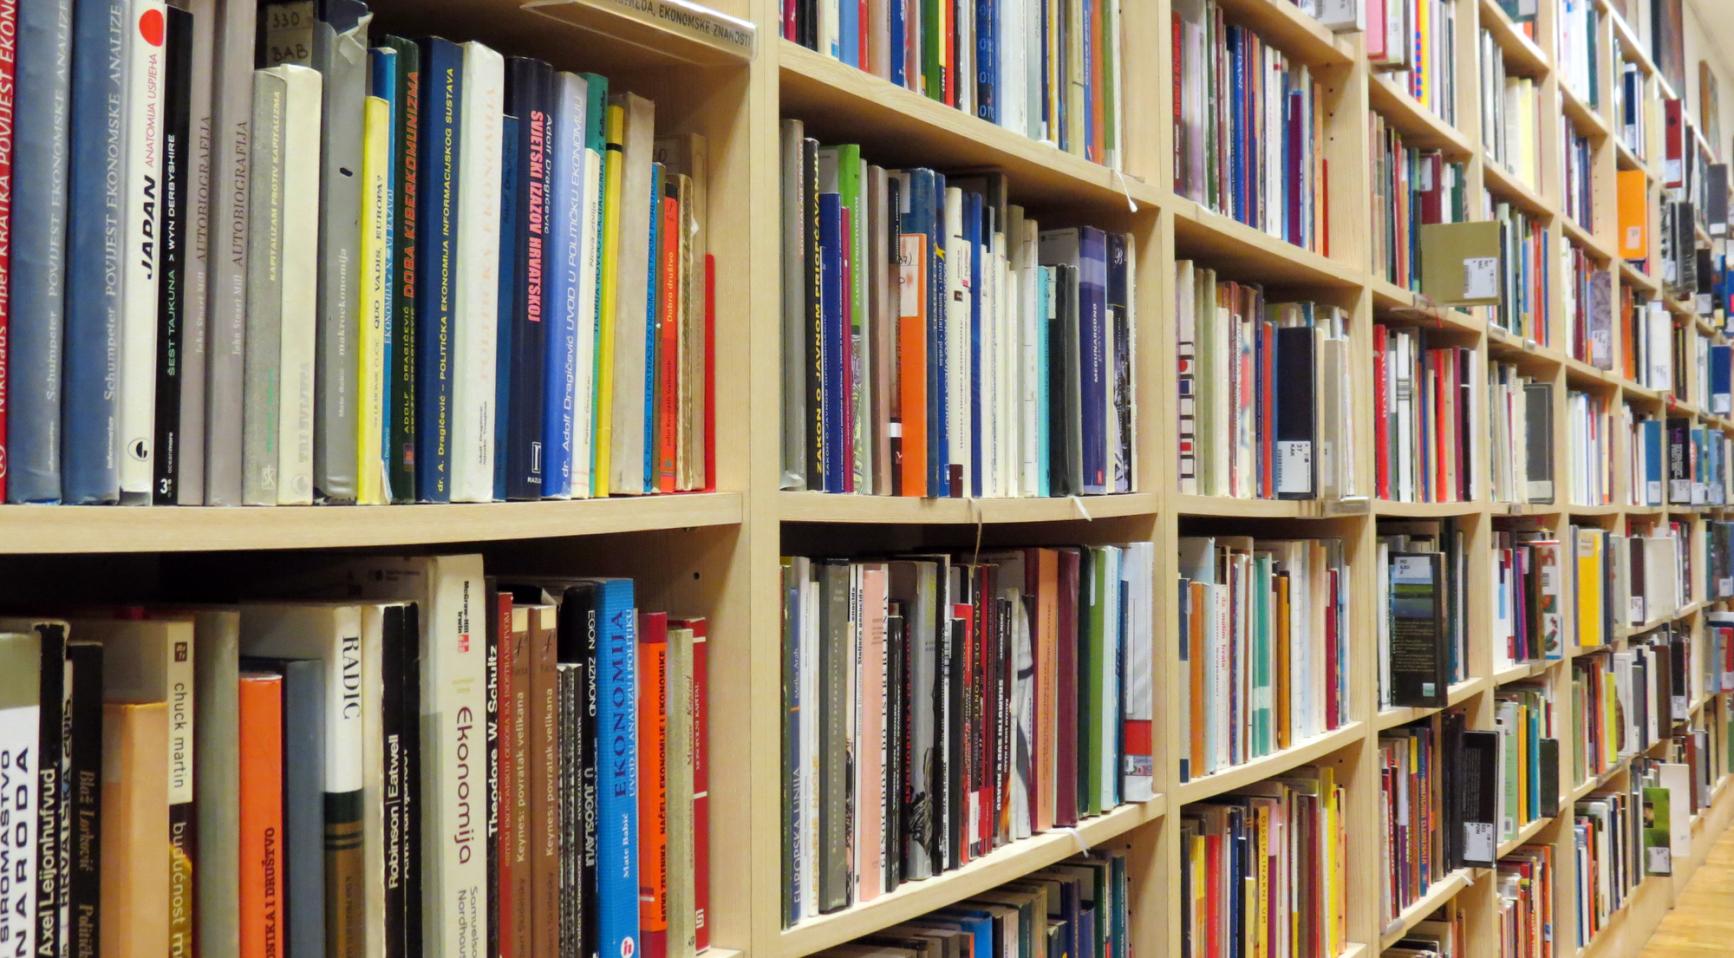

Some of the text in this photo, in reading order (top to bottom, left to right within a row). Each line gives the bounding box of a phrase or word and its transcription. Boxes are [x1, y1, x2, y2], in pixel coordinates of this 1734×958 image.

[659, 4, 710, 34] EKONOMSKE
[0, 69, 13, 165] POVIJEST
[403, 71, 418, 239] KIBERKOMUNIZMA
[544, 113, 553, 155] Adolf
[570, 95, 582, 187] EKONOMIJU
[46, 1, 68, 403] Schumpeter POVIJEST EKONOMSKE ANALIZE
[103, 5, 122, 401] Schumpeter POVIJEST EKONOMSKE ANALIZE
[142, 54, 158, 281] JAPAN ANATOMIJA USPJEHA
[167, 134, 175, 217] DERBYSHIRE
[231, 120, 248, 267] AUTOBIOGRAFIJA
[270, 91, 280, 281] KAPITALIZAM PROTIV KAPITALIZMA
[167, 220, 175, 251] WYN
[527, 110, 544, 323] SVJETSKI IZAZOV HRVATSKOJ
[567, 189, 578, 268] POLITIČKU
[167, 270, 176, 334] TAJKUNA
[337, 248, 348, 357] makroekonomija
[403, 246, 415, 298] DOBA
[437, 67, 454, 492] dr. A. Dragičević POLITIČKA EKONOMIJA INFORMACIJSKOG SUSTAVA
[566, 287, 576, 331] UVOD
[569, 271, 576, 283] U
[167, 339, 176, 377] ŠEST
[562, 334, 574, 411] Dragičević
[816, 386, 822, 402] O
[562, 415, 571, 452] Adolf
[588, 610, 596, 717] EGON ZIZMOND
[625, 608, 634, 672] POLITIKU
[487, 644, 499, 837] Theodore W. Schultz
[515, 691, 525, 746] velikana
[544, 688, 554, 742] velikana
[611, 610, 627, 799] EKONOMIJA
[626, 689, 635, 744] ANALIZU
[172, 682, 187, 925] chuck martin budućnost
[387, 734, 399, 889] Robinson Eatwell
[454, 706, 474, 865] Ekonomija
[515, 750, 526, 807] povratak
[545, 745, 555, 802] povratak
[628, 754, 636, 797] UVOD
[15, 746, 29, 958] NARODA
[584, 767, 595, 867] U JUGOSLAVIJI
[620, 812, 630, 846] Babić
[38, 768, 57, 957] Axel Leijonhufvud
[261, 827, 276, 898] DRUŠTVO
[621, 847, 630, 878] Mate
